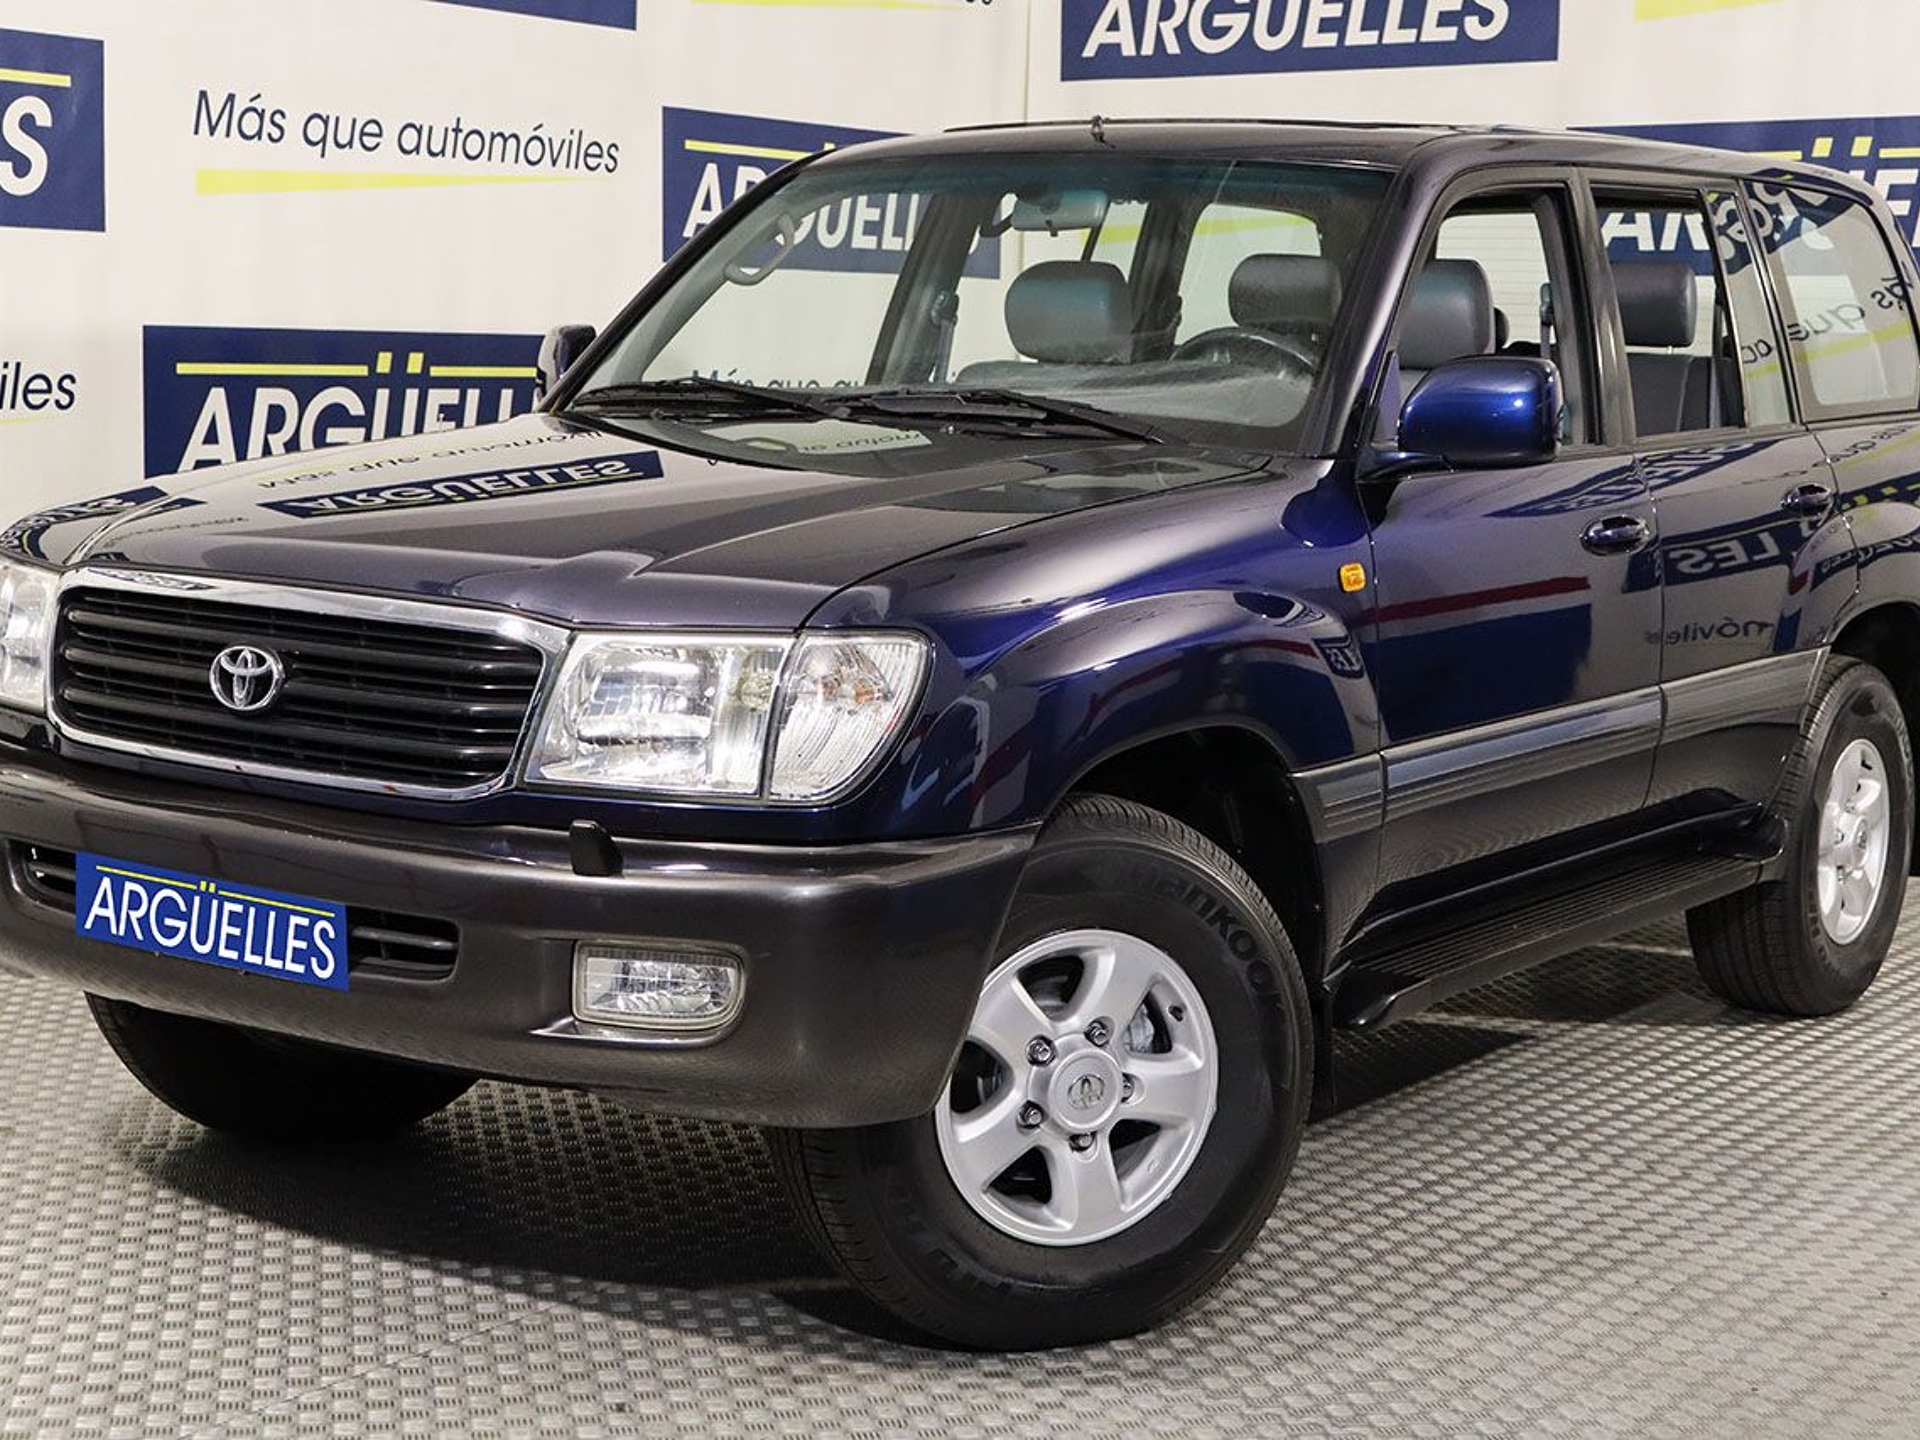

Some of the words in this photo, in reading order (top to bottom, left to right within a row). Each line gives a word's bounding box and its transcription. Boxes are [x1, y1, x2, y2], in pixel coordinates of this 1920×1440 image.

[193, 89, 287, 144] Más
[302, 112, 384, 159] que
[397, 117, 620, 173] automóviles
[83, 874, 337, 981] ARGÜELLES
